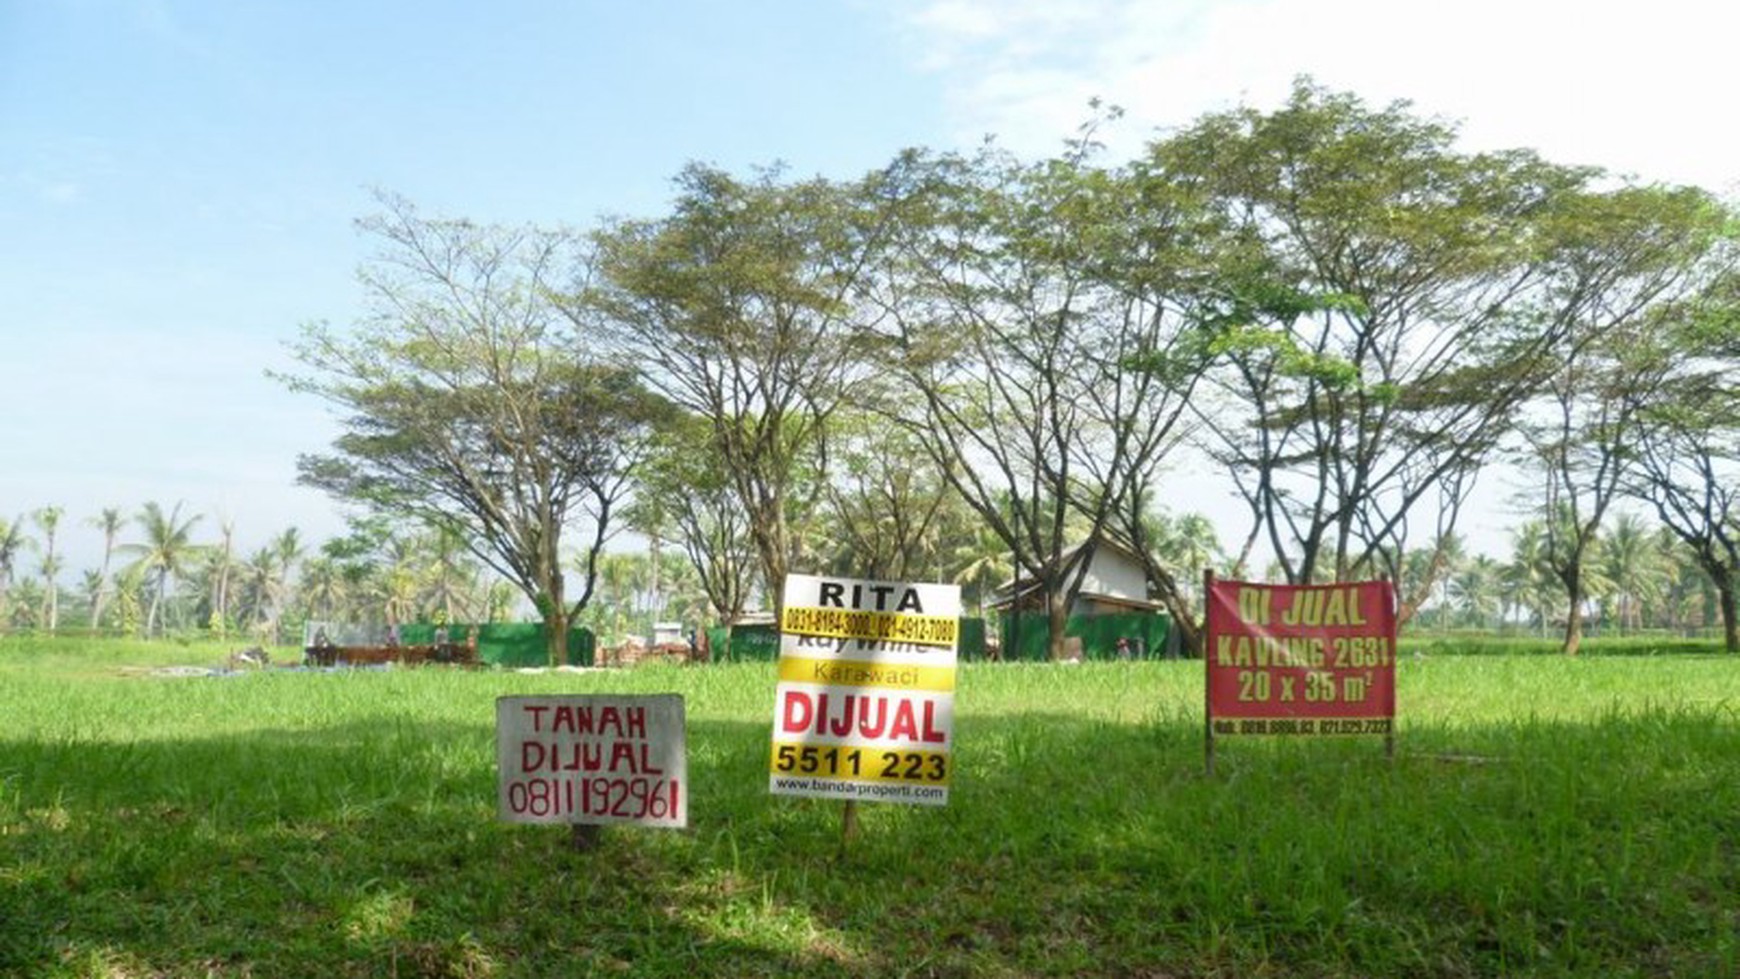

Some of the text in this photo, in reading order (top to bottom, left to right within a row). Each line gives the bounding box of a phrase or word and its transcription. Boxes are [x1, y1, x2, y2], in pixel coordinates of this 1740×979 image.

[819, 582, 923, 614] RITA
[1238, 587, 1367, 626] DI JUAL
[1217, 635, 1389, 668] KAVLING 2631
[813, 662, 920, 686] Karawaci
[1238, 670, 1271, 702] 20
[1280, 676, 1295, 702] x
[1305, 671, 1335, 702] 35
[523, 706, 646, 738] TANAH
[782, 691, 945, 743] DIJUAL
[522, 741, 662, 774] DIJUAL
[777, 746, 945, 780] 5511 223
[509, 777, 678, 819] 0811192961
[776, 778, 944, 799] www.bandarproperti.com
